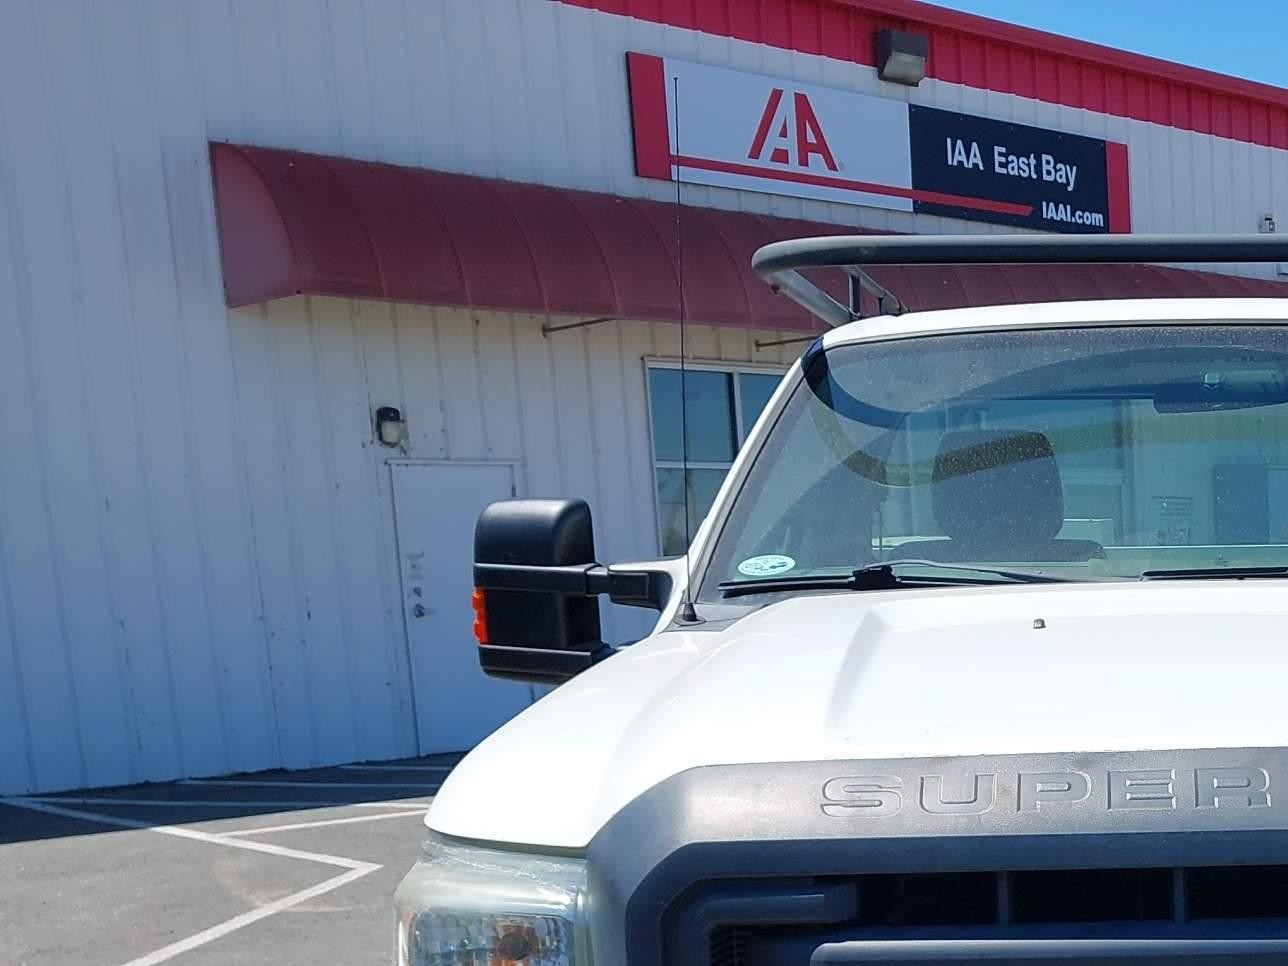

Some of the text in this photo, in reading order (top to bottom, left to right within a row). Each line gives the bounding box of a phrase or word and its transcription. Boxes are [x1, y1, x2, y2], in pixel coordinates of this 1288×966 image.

[946, 137, 1077, 192] IAA East Bay
[1042, 201, 1104, 227] IAAI.com
[820, 767, 1272, 818] SUPER
